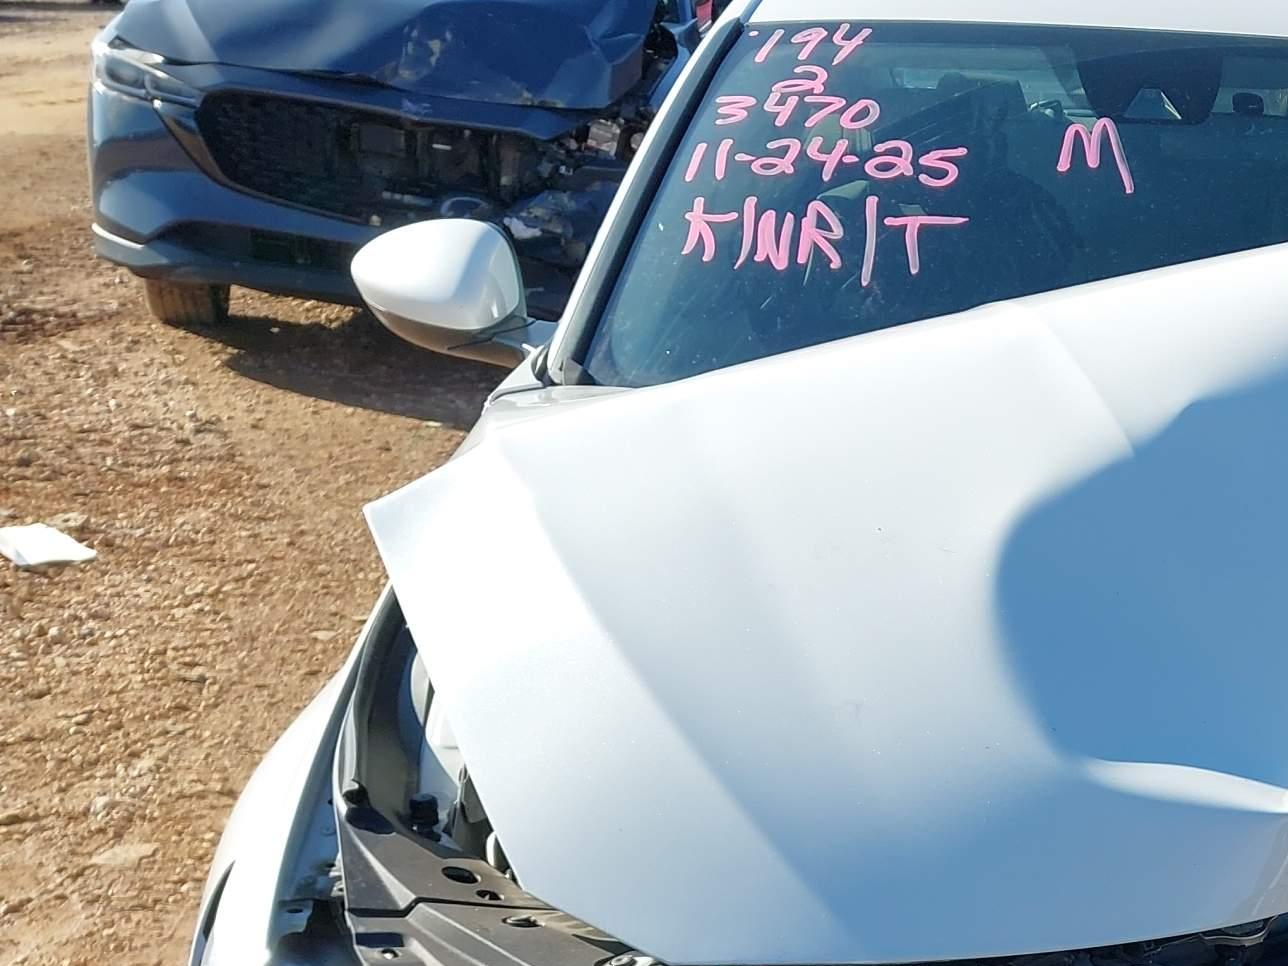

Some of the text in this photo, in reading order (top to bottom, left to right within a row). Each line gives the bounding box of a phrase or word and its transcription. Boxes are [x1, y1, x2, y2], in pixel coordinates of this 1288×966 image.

[771, 65, 829, 94] 2
[716, 93, 881, 129] 3470
[684, 138, 967, 187] 11-24-25
[1056, 118, 1135, 193] M
